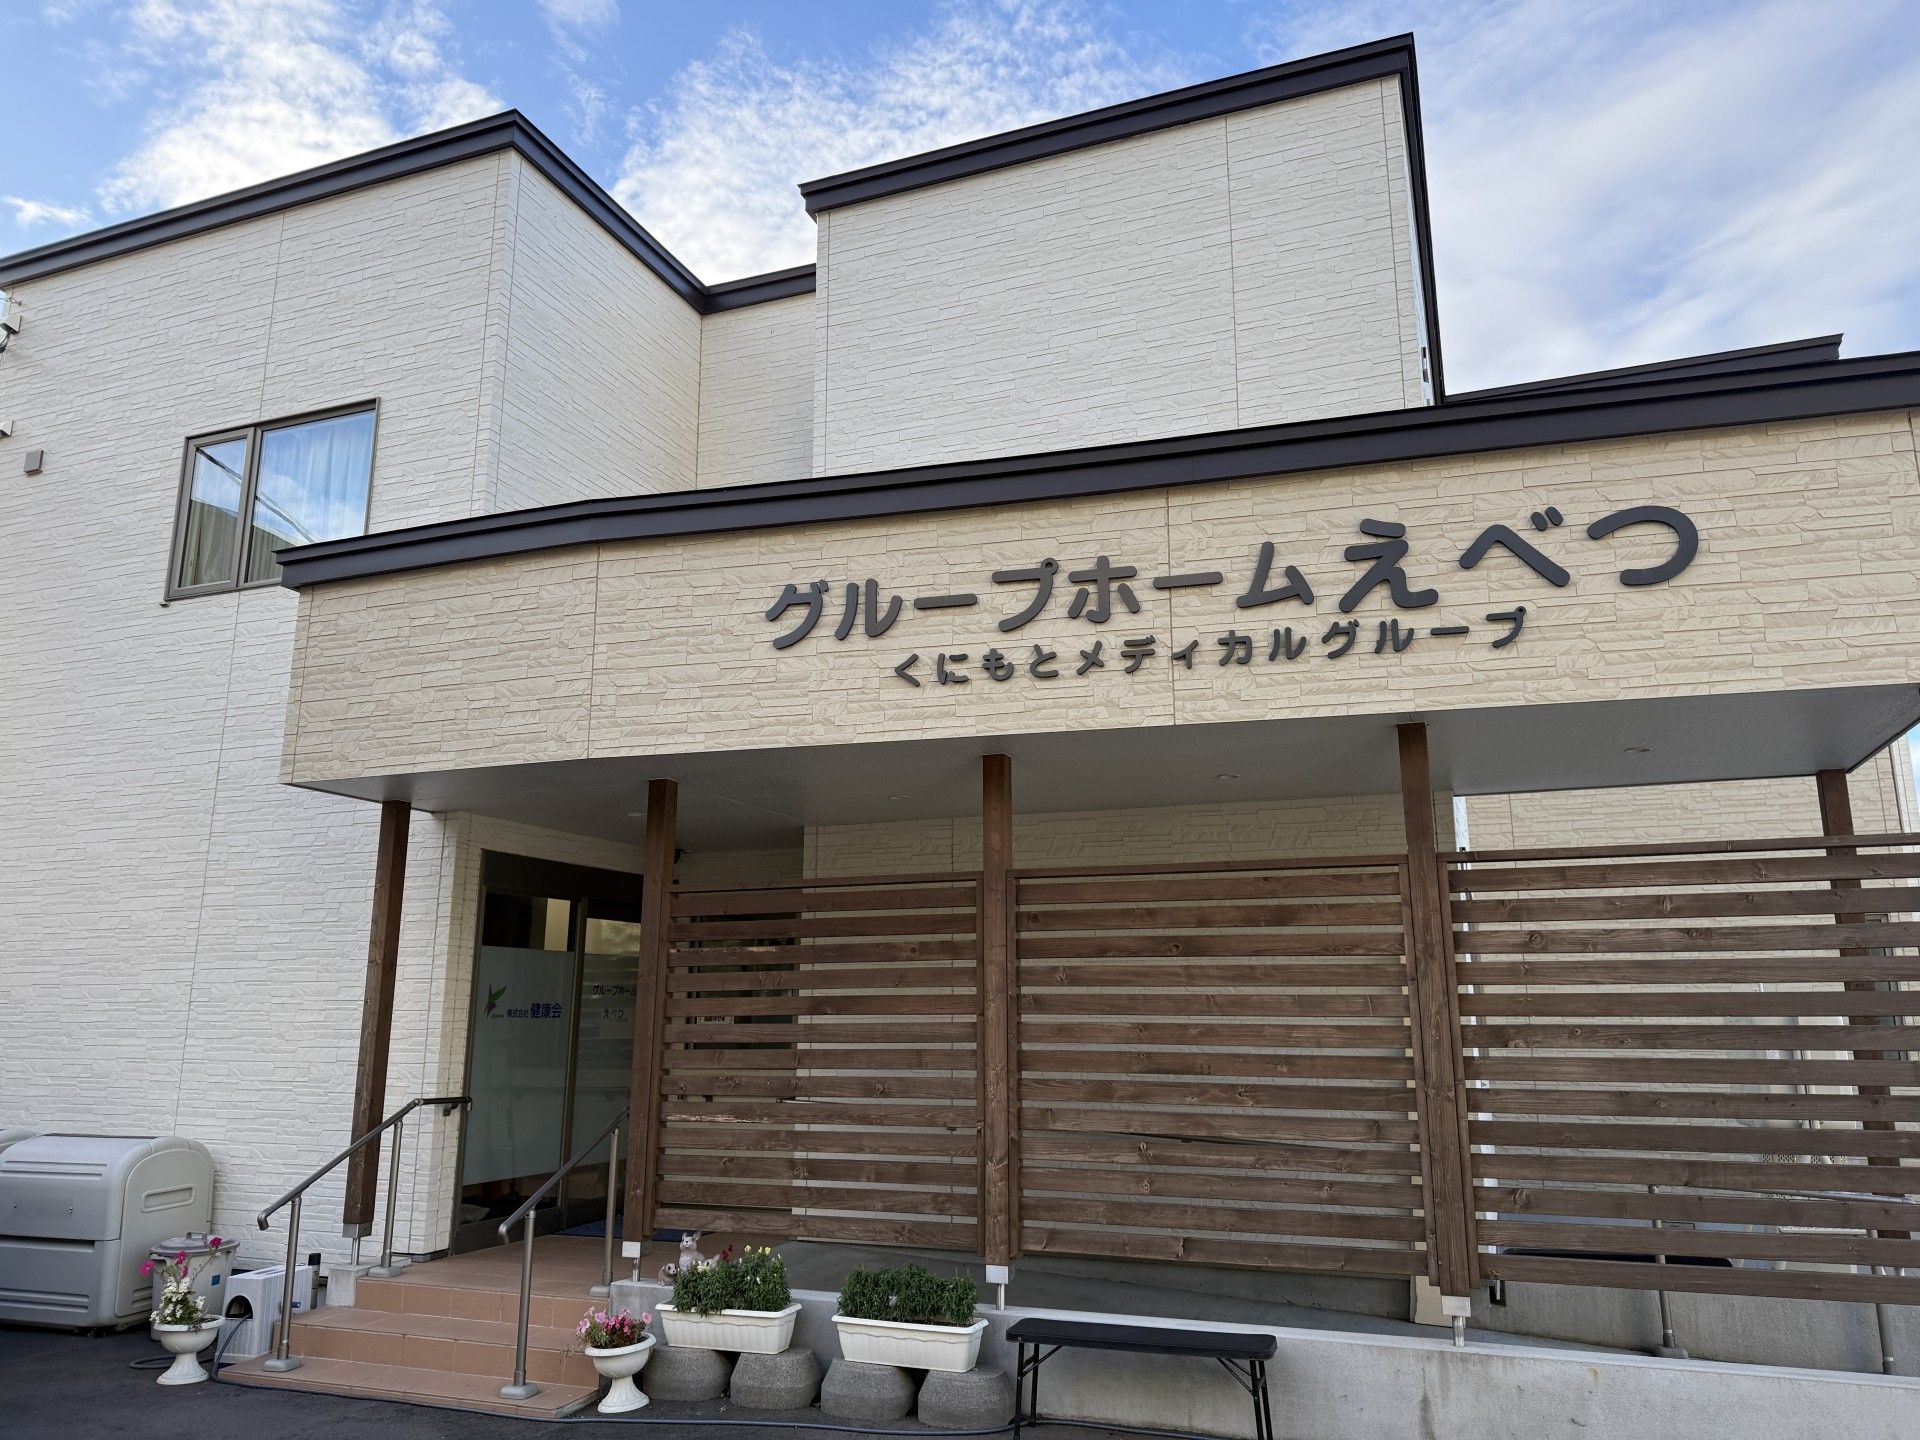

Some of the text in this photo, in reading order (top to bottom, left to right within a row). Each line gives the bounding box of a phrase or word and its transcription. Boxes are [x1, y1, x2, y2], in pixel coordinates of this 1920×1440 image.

[765, 505, 1700, 652] グループホームえべつ
[890, 605, 1527, 688] くにもとメディカルグループ
